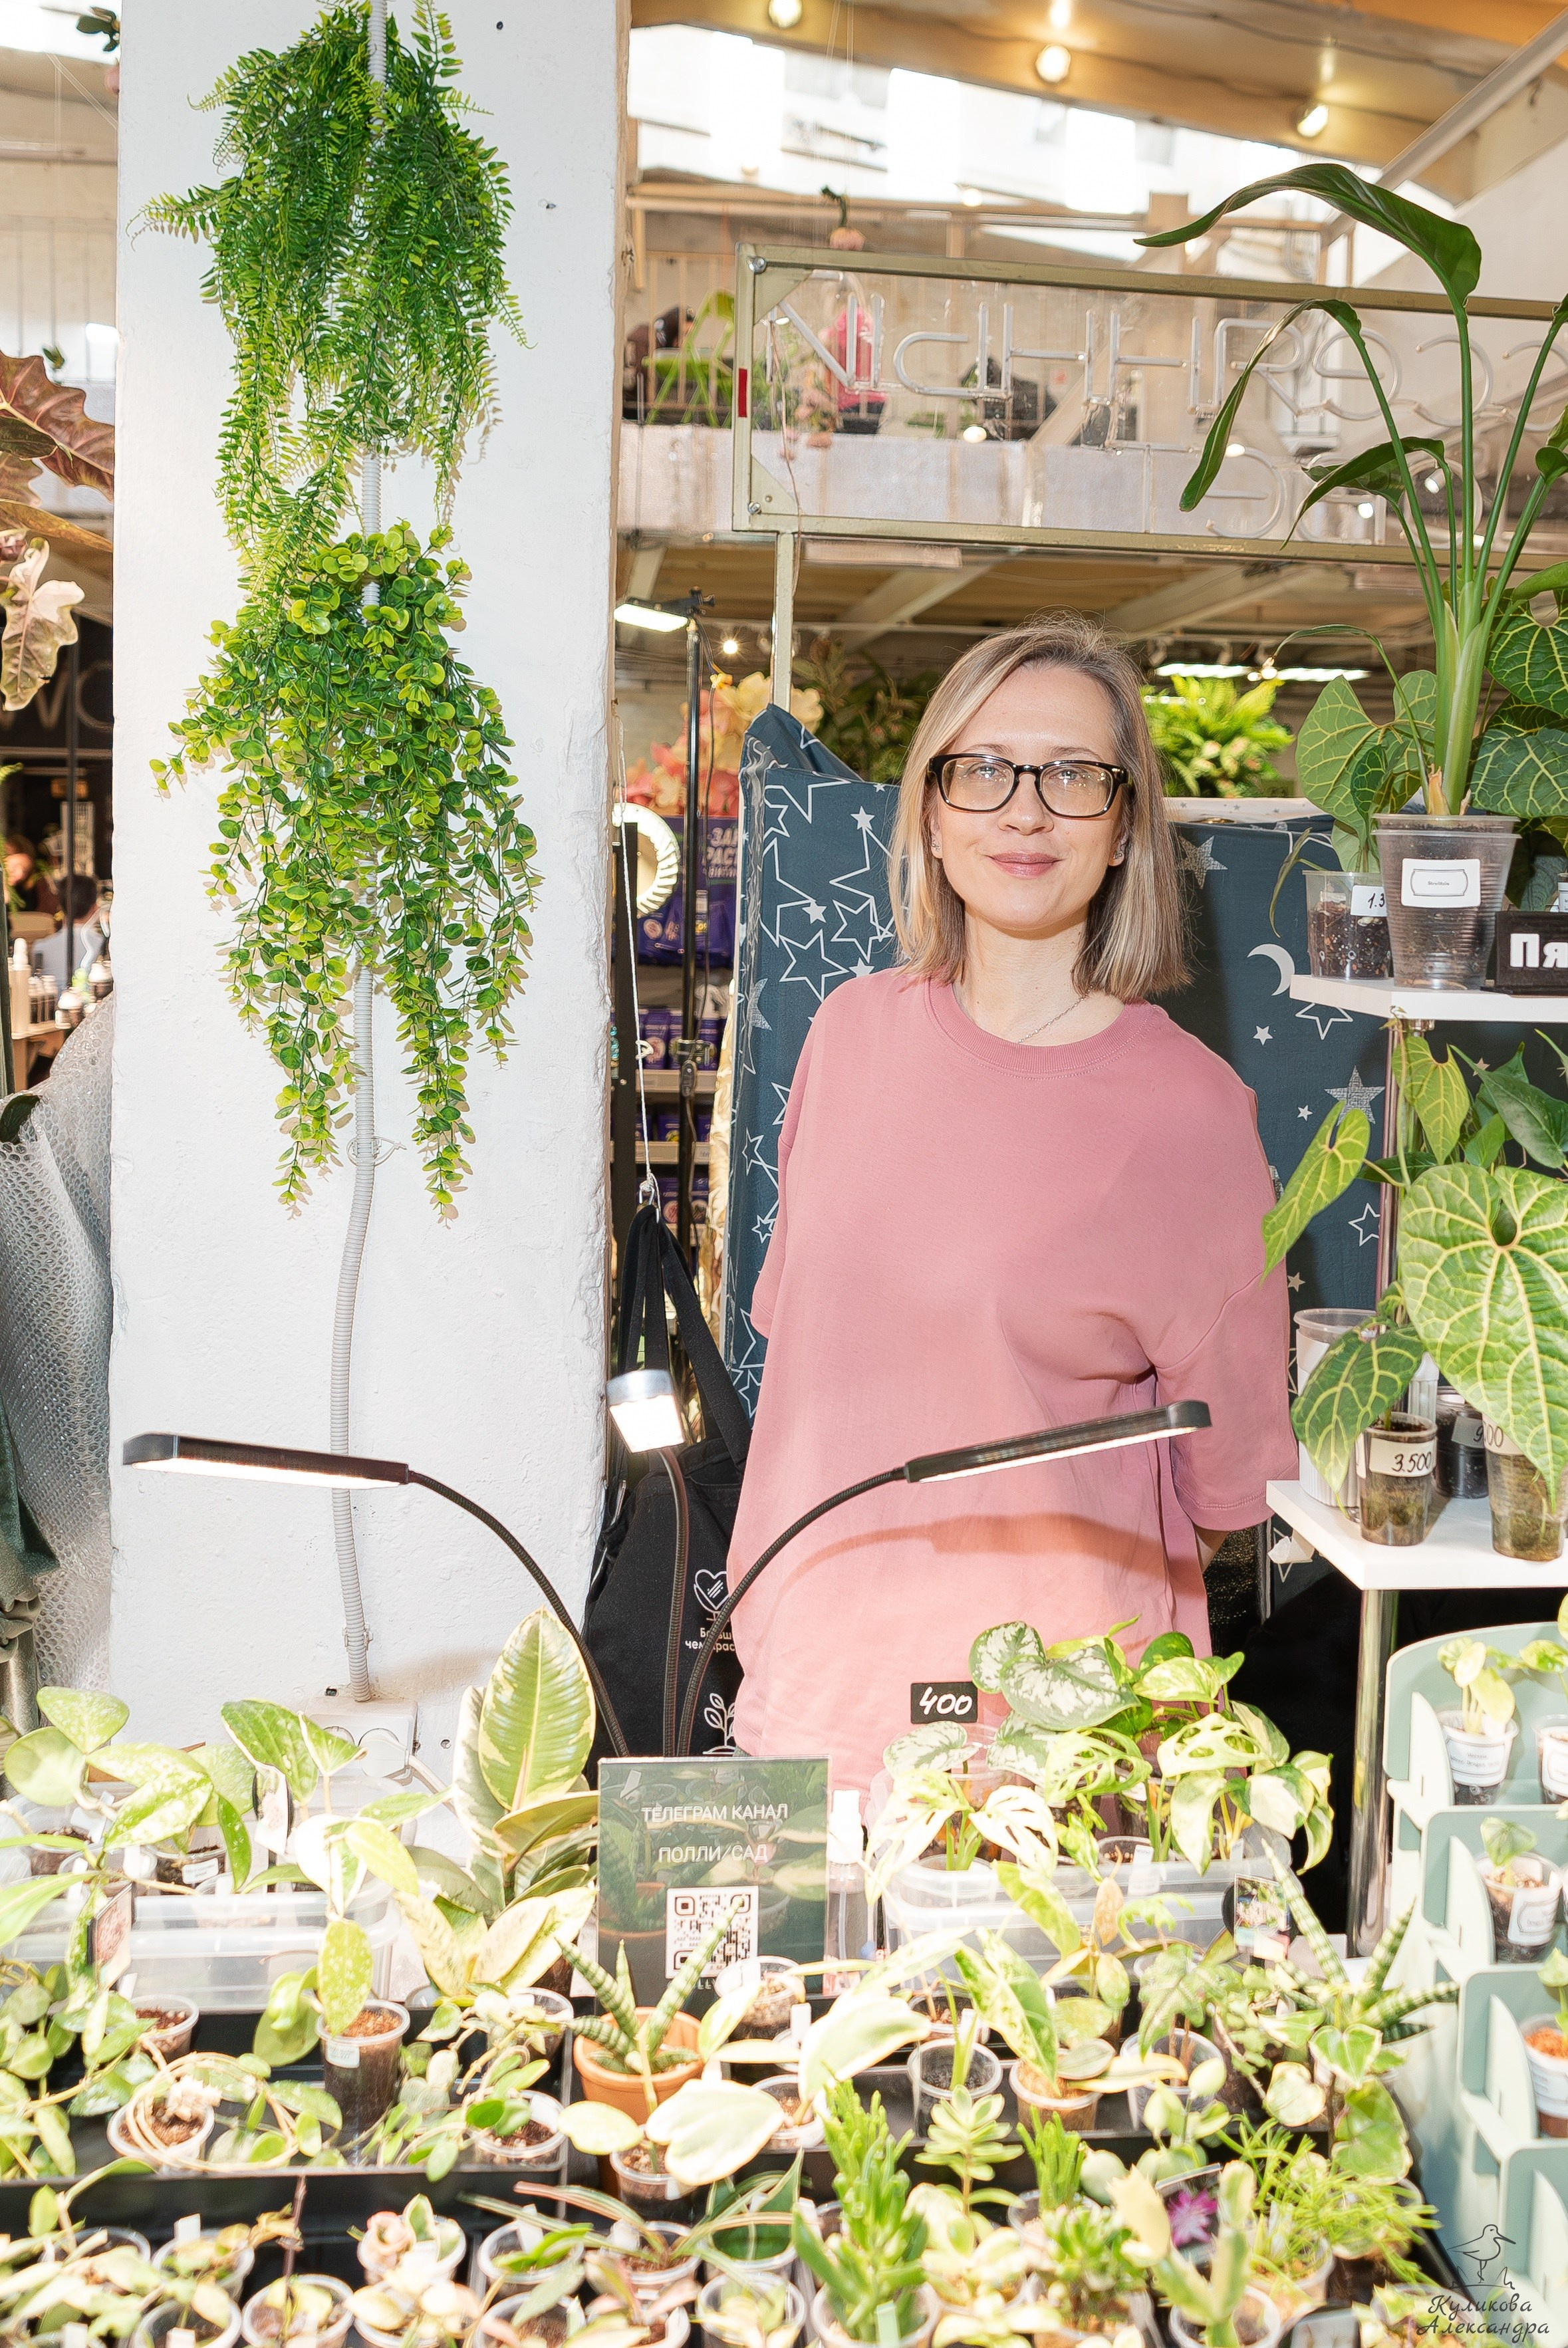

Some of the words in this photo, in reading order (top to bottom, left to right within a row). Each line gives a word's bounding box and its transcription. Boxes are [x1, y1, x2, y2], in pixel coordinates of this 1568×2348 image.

[1391, 1451, 1432, 1472] 3.500
[919, 1686, 973, 1716] 400
[640, 1804, 727, 1823] ТЕЛЕГРАМ
[731, 1803, 789, 1820] КАНАЛ
